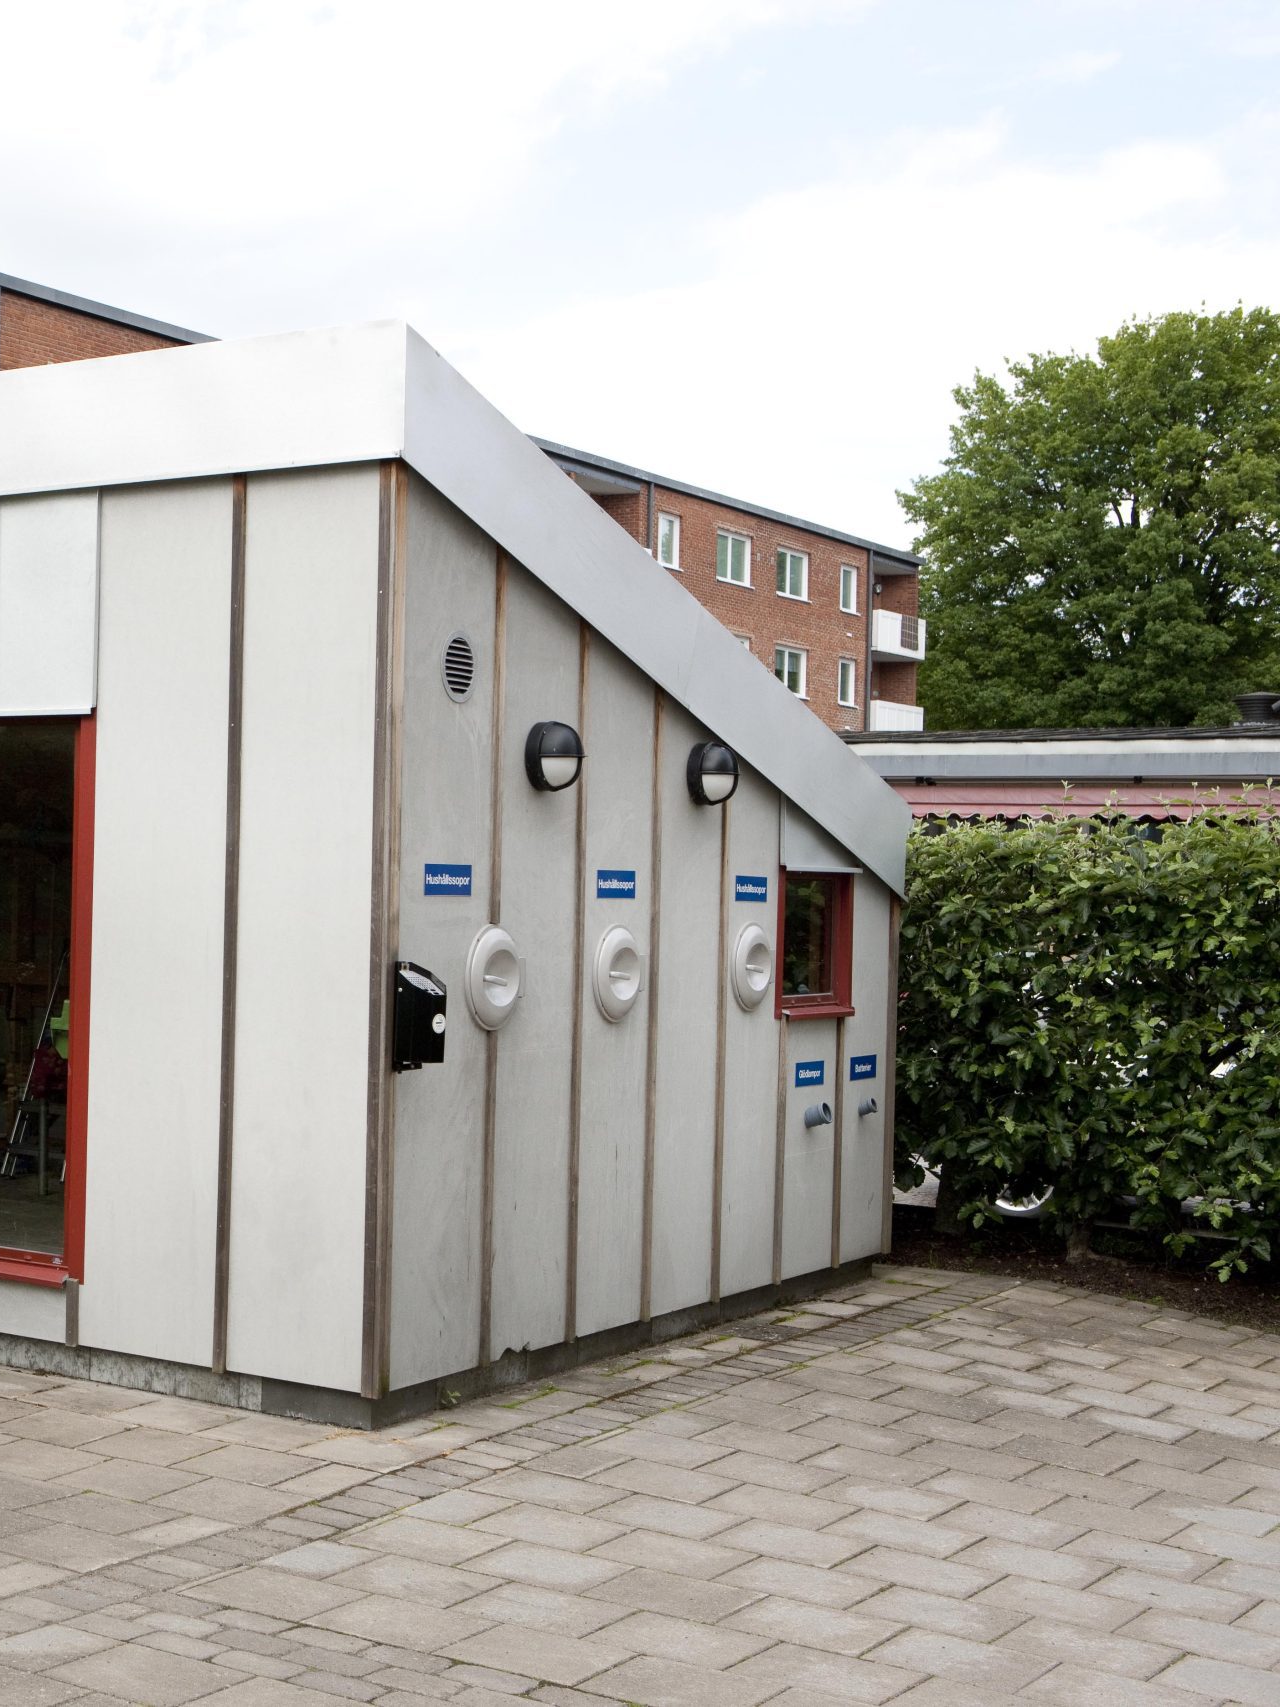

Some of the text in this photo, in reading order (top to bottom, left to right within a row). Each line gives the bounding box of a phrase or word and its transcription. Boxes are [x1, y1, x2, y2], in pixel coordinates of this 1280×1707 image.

[425, 873, 471, 888] Hushållssopor
[598, 878, 635, 891] Hushållssopor
[736, 883, 767, 896] Hushållssopor
